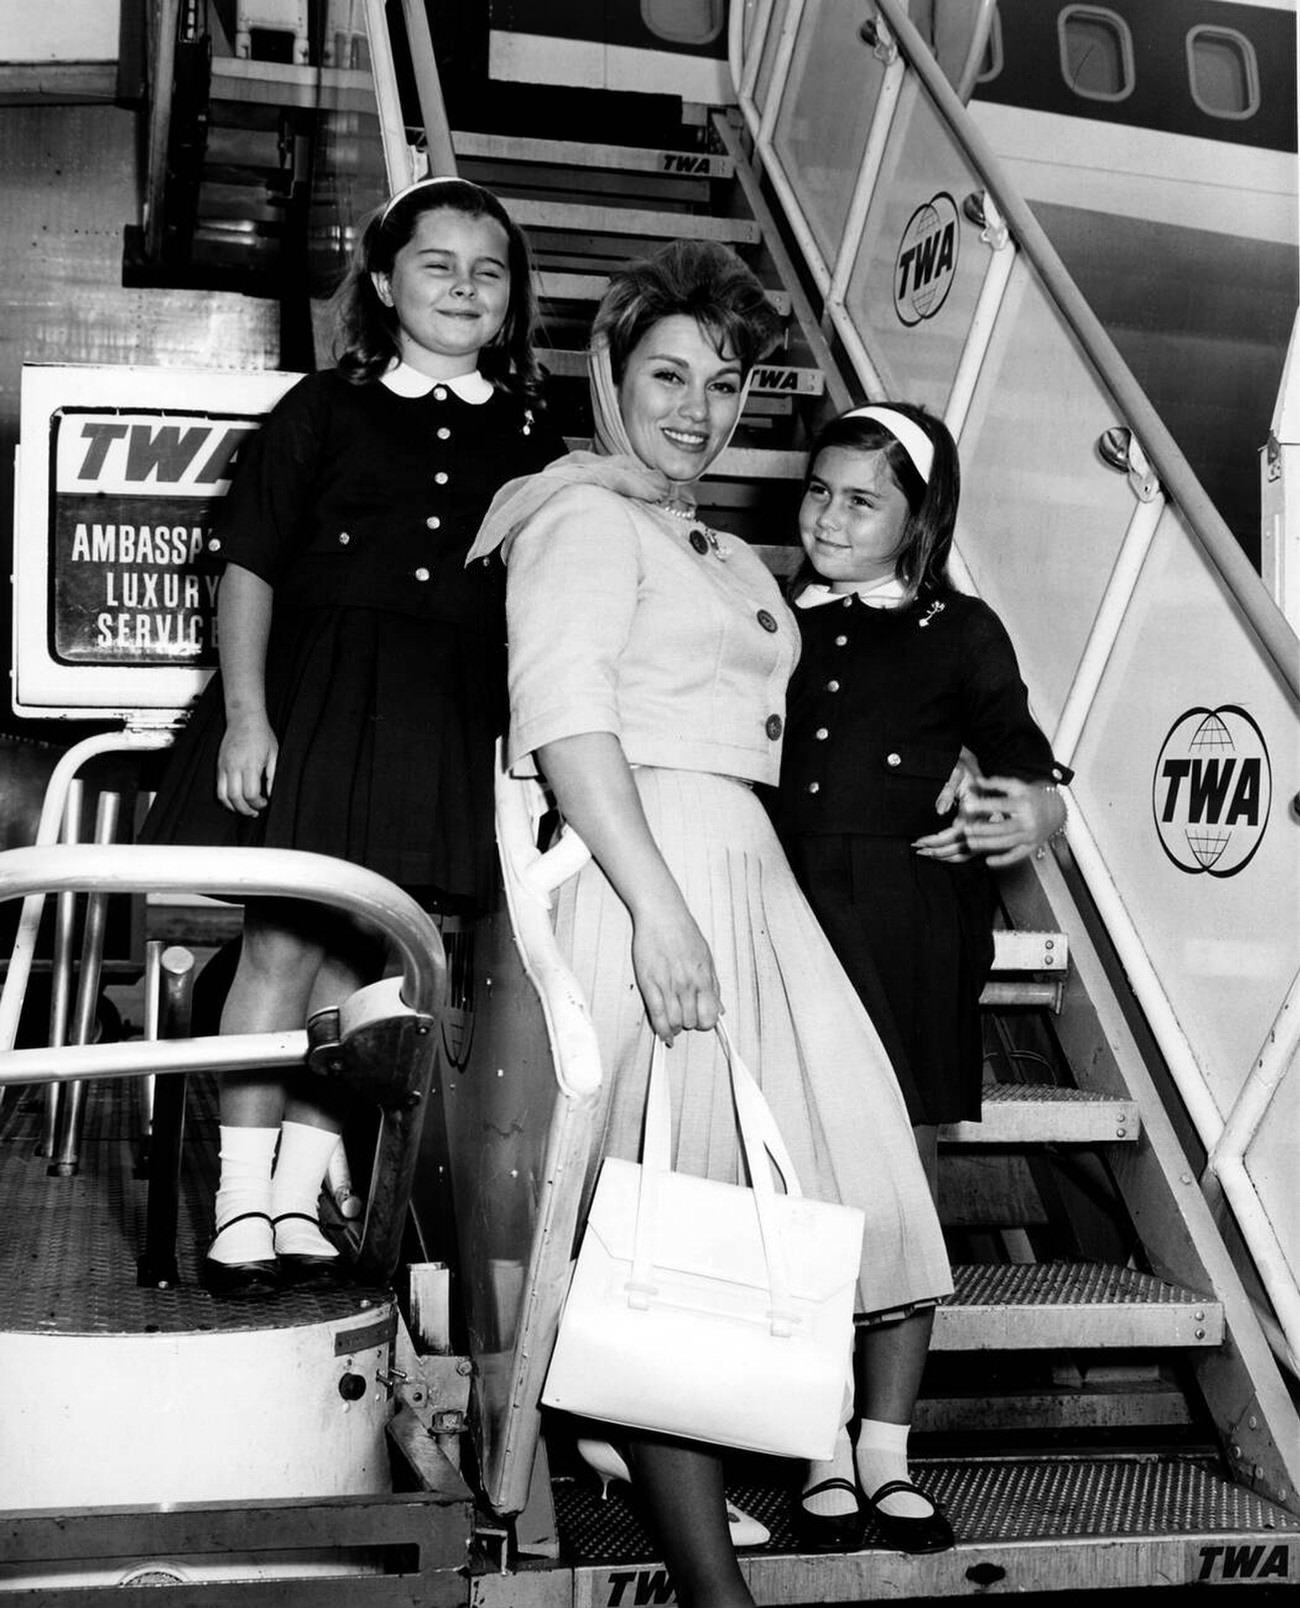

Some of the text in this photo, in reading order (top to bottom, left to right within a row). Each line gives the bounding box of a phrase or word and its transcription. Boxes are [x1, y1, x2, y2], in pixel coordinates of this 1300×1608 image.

[664, 154, 710, 174] TWA
[899, 220, 954, 300] TWA
[71, 523, 213, 565] AMBASSA
[106, 572, 219, 608] LUXURY
[1162, 758, 1260, 826] TWA
[1199, 1545, 1289, 1579] TWA
[607, 1570, 677, 1607] TW
